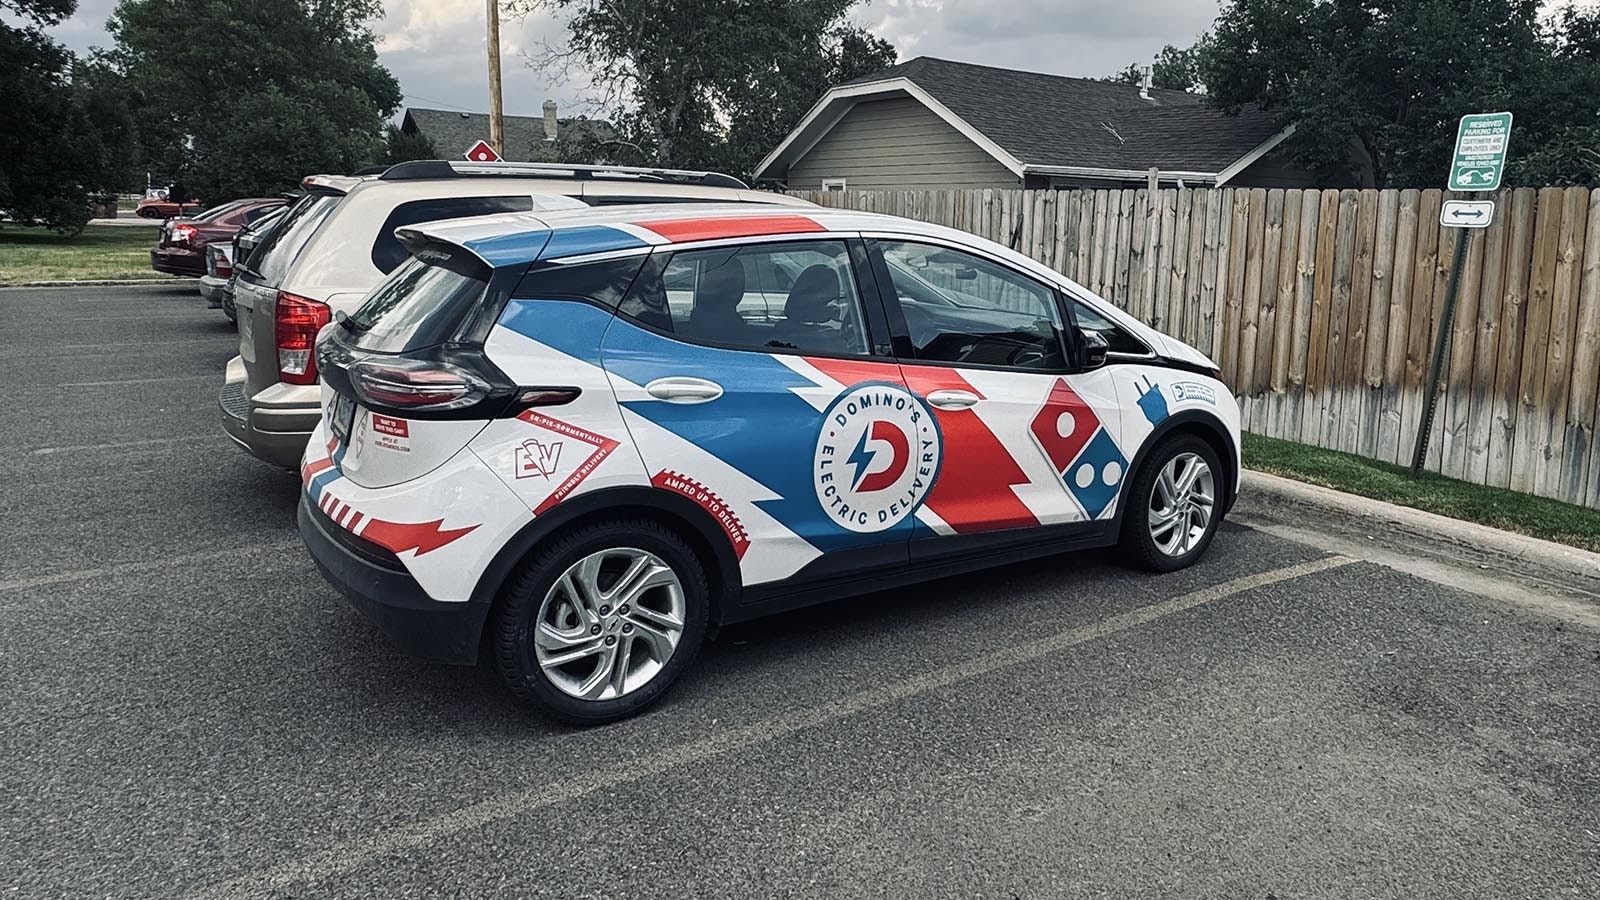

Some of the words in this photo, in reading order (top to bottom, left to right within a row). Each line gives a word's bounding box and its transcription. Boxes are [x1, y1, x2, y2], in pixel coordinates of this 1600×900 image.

[1492, 127, 1505, 135] FOR
[835, 393, 921, 428] DOMINO'S
[555, 474, 582, 500] FRIENDLY
[582, 448, 607, 475] DELIVERY
[820, 445, 868, 525] ELECTRIC
[878, 440, 933, 523] DELIVERY
[664, 477, 696, 496] AMPED
[696, 491, 709, 503] UP
[708, 501, 720, 512] TO
[718, 511, 743, 544] DELIVER
